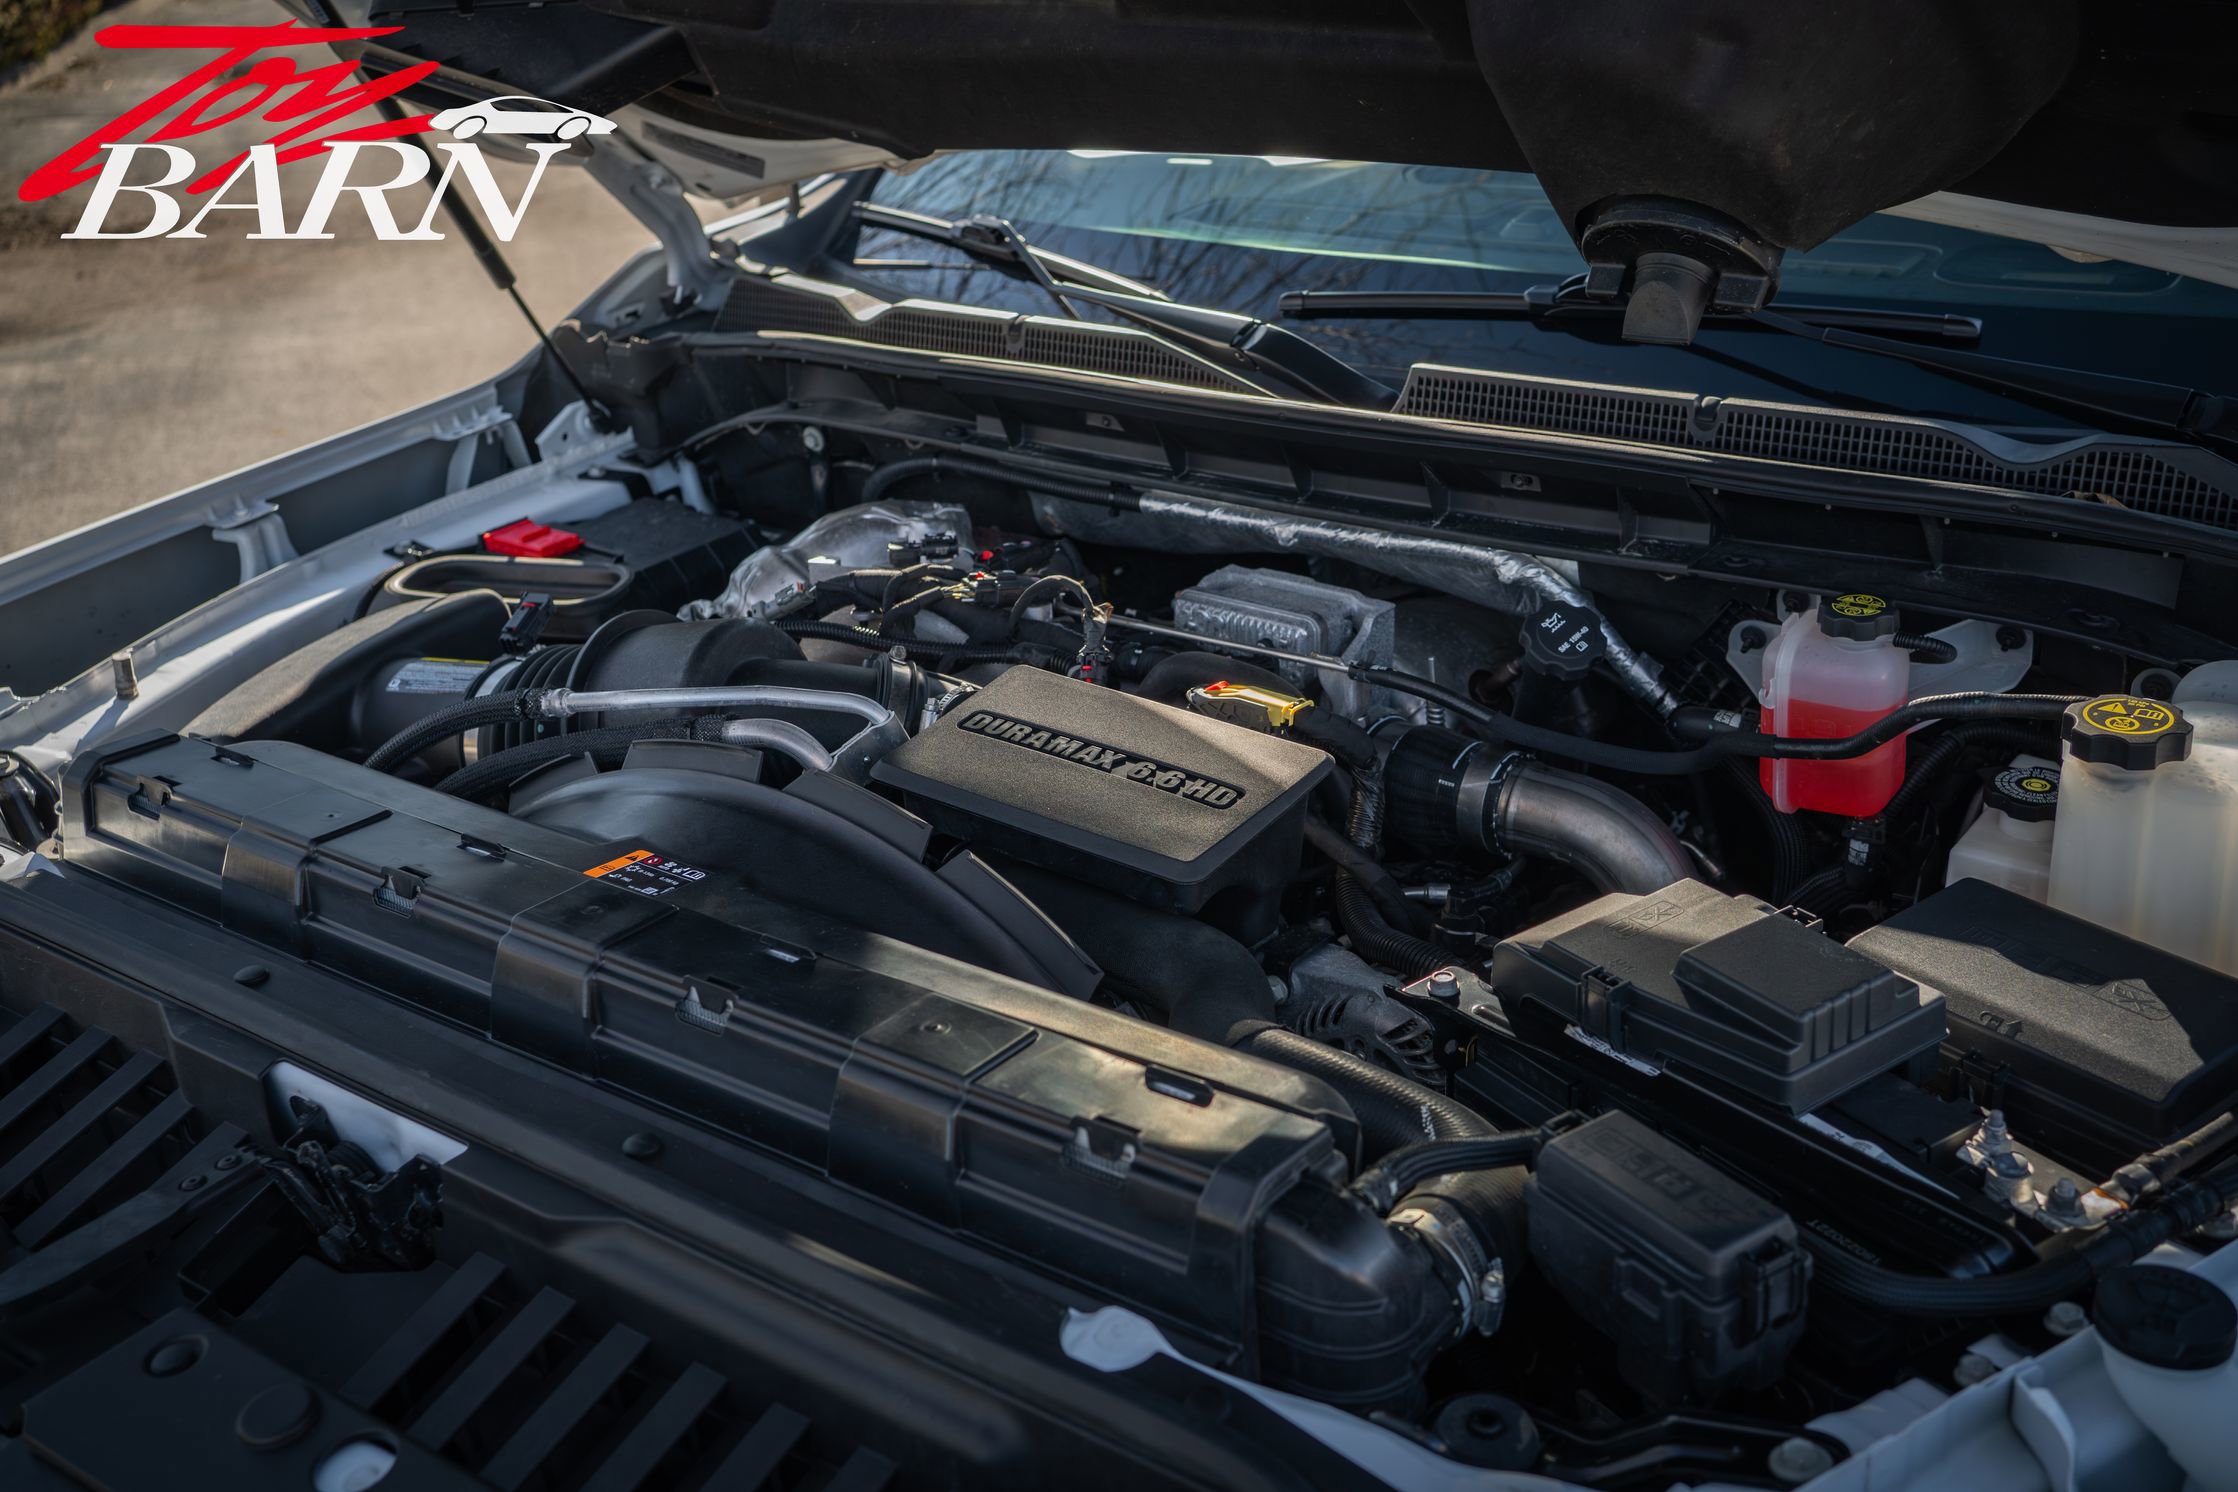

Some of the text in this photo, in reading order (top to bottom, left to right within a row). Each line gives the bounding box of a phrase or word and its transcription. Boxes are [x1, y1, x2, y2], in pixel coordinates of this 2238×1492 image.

[962, 712, 1238, 804] DURAMAX 6.6 HD
